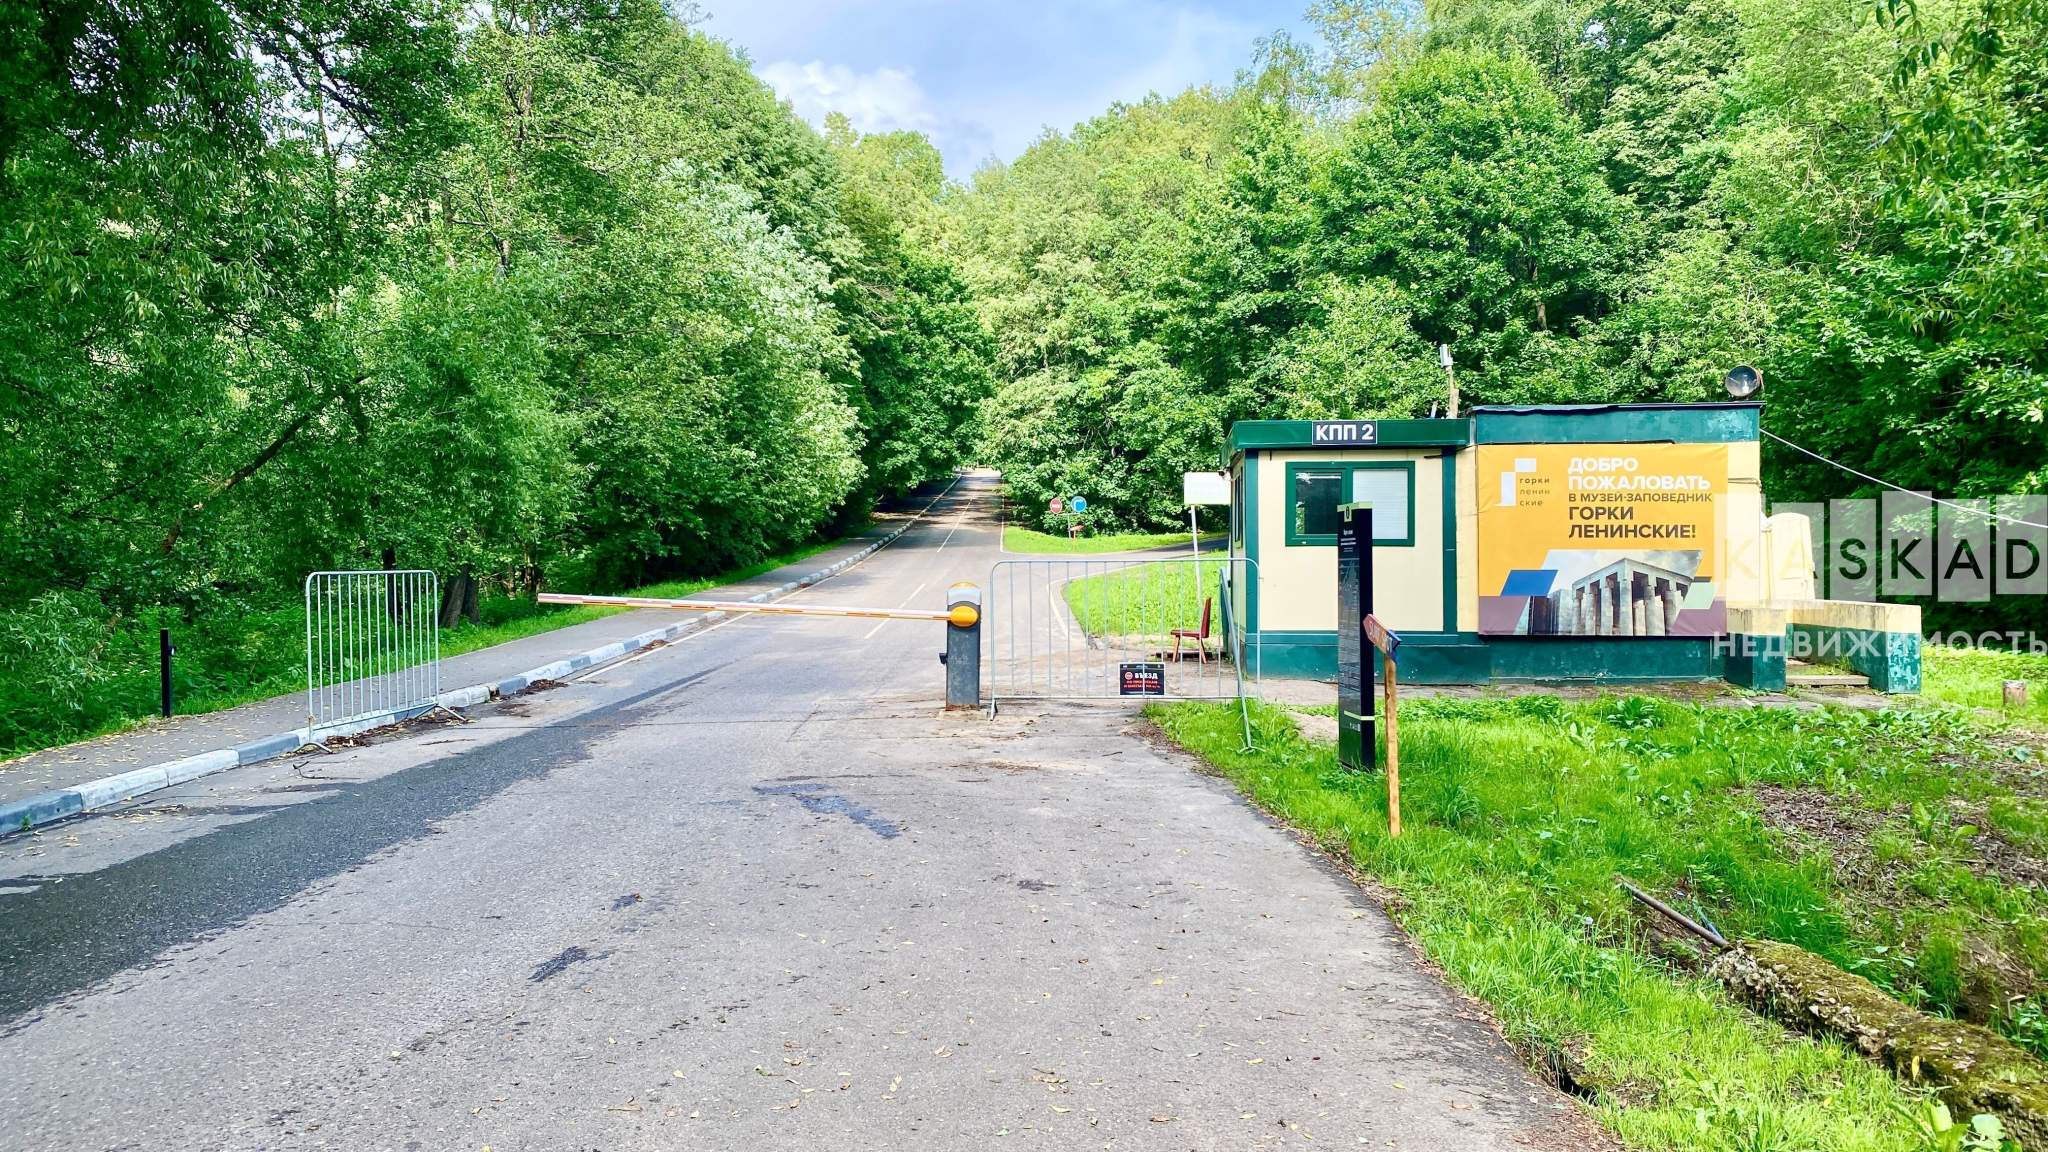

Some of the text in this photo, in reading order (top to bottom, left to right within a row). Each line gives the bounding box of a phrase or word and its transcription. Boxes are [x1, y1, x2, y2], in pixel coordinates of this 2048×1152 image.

[1316, 424, 1374, 440] КПП 2
[1568, 457, 1639, 474] ДОБРО
[1519, 478, 1550, 486] горки
[1568, 475, 1711, 490] ПОЖАЛОВАТЬ
[1569, 492, 1713, 503] В МУЗЕЙ-ЗАПОВЕДНИК
[1568, 506, 1634, 520] ГОРКИ
[1568, 524, 1697, 539] ЛЕНИНСКИЕ!
